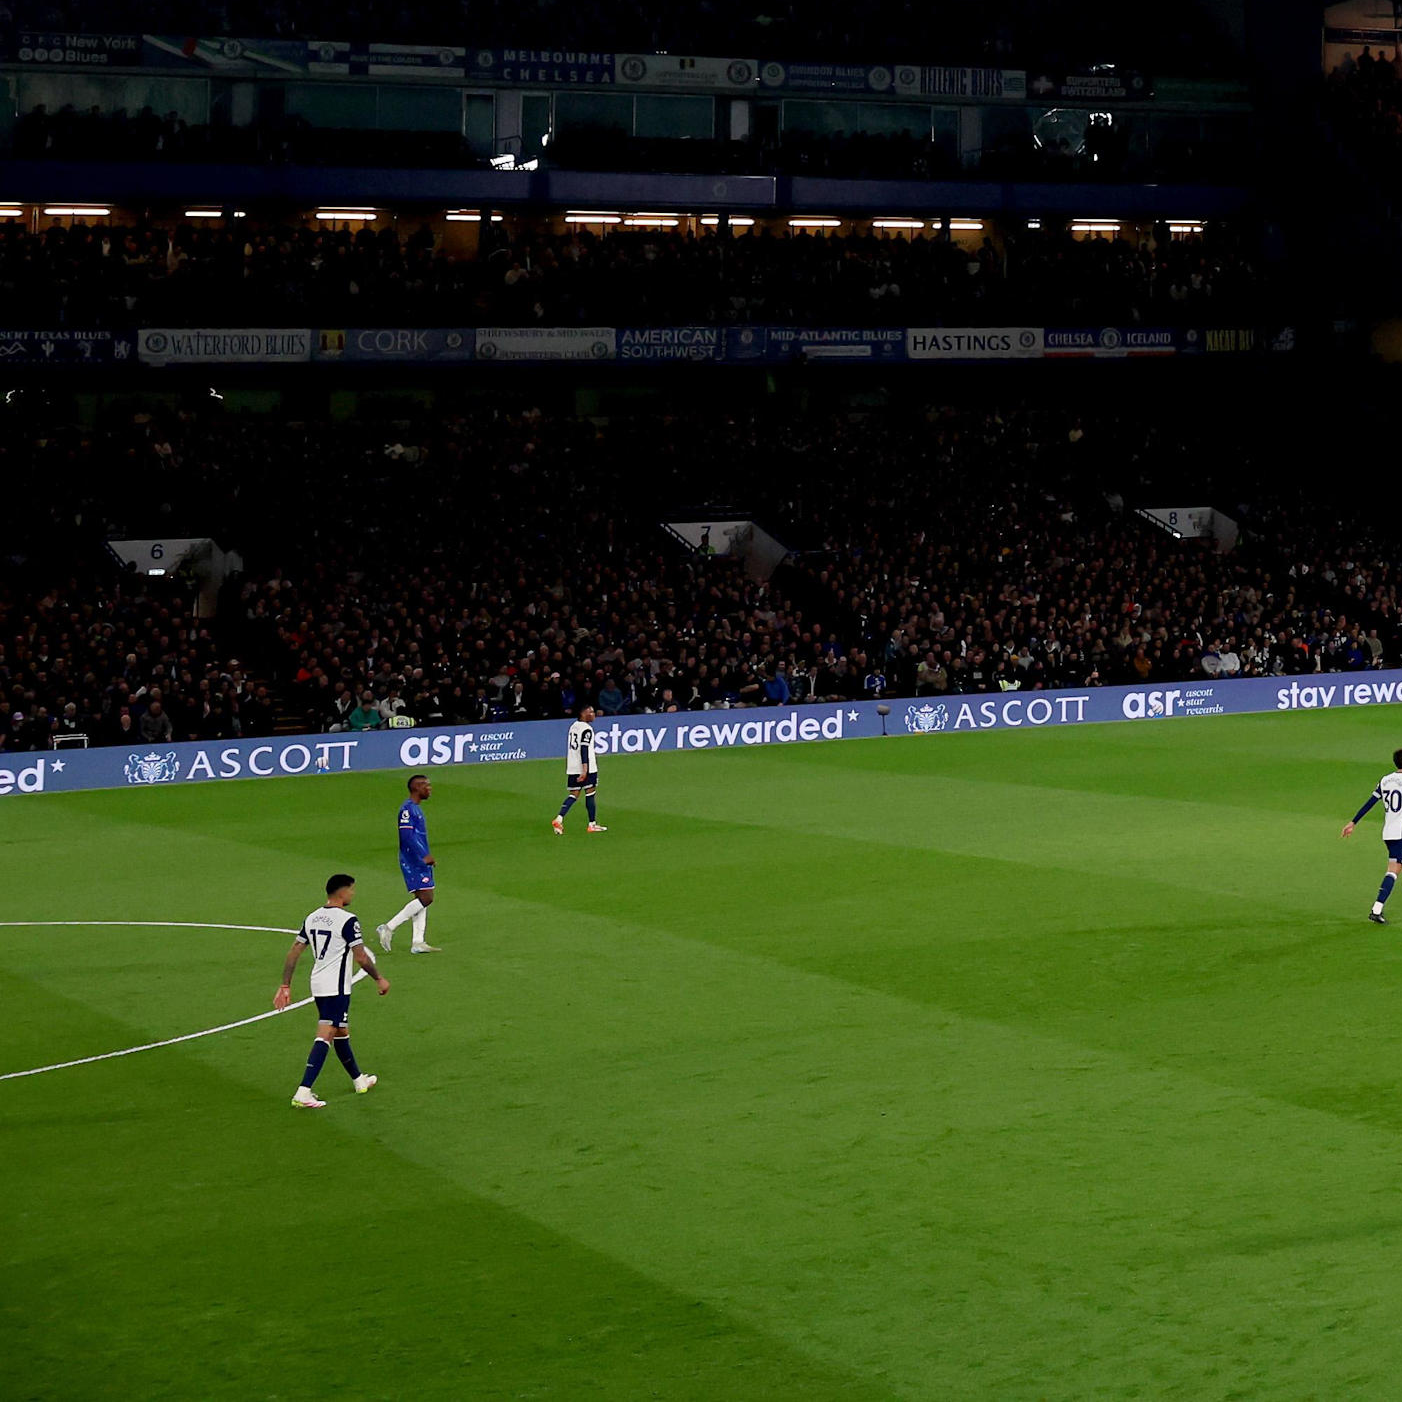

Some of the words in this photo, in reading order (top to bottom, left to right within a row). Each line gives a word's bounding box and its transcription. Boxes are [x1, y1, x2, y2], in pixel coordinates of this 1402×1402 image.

[65, 35, 98, 48] New
[103, 36, 136, 50] York
[65, 50, 108, 63] Blues
[503, 49, 612, 65] MELBOURNE
[503, 68, 611, 83] CHELSEA
[34, 331, 70, 341] TEXAS
[74, 331, 112, 341] BLUES
[358, 330, 428, 351] CORK
[622, 329, 716, 344] AMERICAN
[770, 330, 860, 341] MID-ATLANTIC
[863, 330, 903, 341] BLUES
[913, 335, 1011, 351] HASTINGS
[1049, 334, 1094, 345] CHELSEA
[1127, 333, 1171, 344] ICELAND
[168, 332, 261, 355] WATERFORD
[266, 334, 306, 355] BLUES
[621, 345, 715, 359] SOUTHWEST
[1168, 512, 1179, 525] 8
[151, 544, 163, 559] 6
[1186, 687, 1214, 698] ascott
[1277, 681, 1336, 710] stay
[1122, 688, 1182, 719] asr
[1186, 698, 1205, 707] star
[1186, 704, 1224, 716] rewards
[954, 696, 1090, 730] ASCOTT
[479, 729, 514, 741] ascott
[594, 722, 667, 756] stay
[676, 709, 844, 749] rewarded
[400, 729, 473, 767] asr
[479, 741, 504, 751] star
[569, 732, 579, 751] 13
[186, 741, 358, 780] ASCOTT
[479, 750, 527, 762] rewards
[1382, 790, 1402, 813] 30
[310, 929, 332, 960] 17
